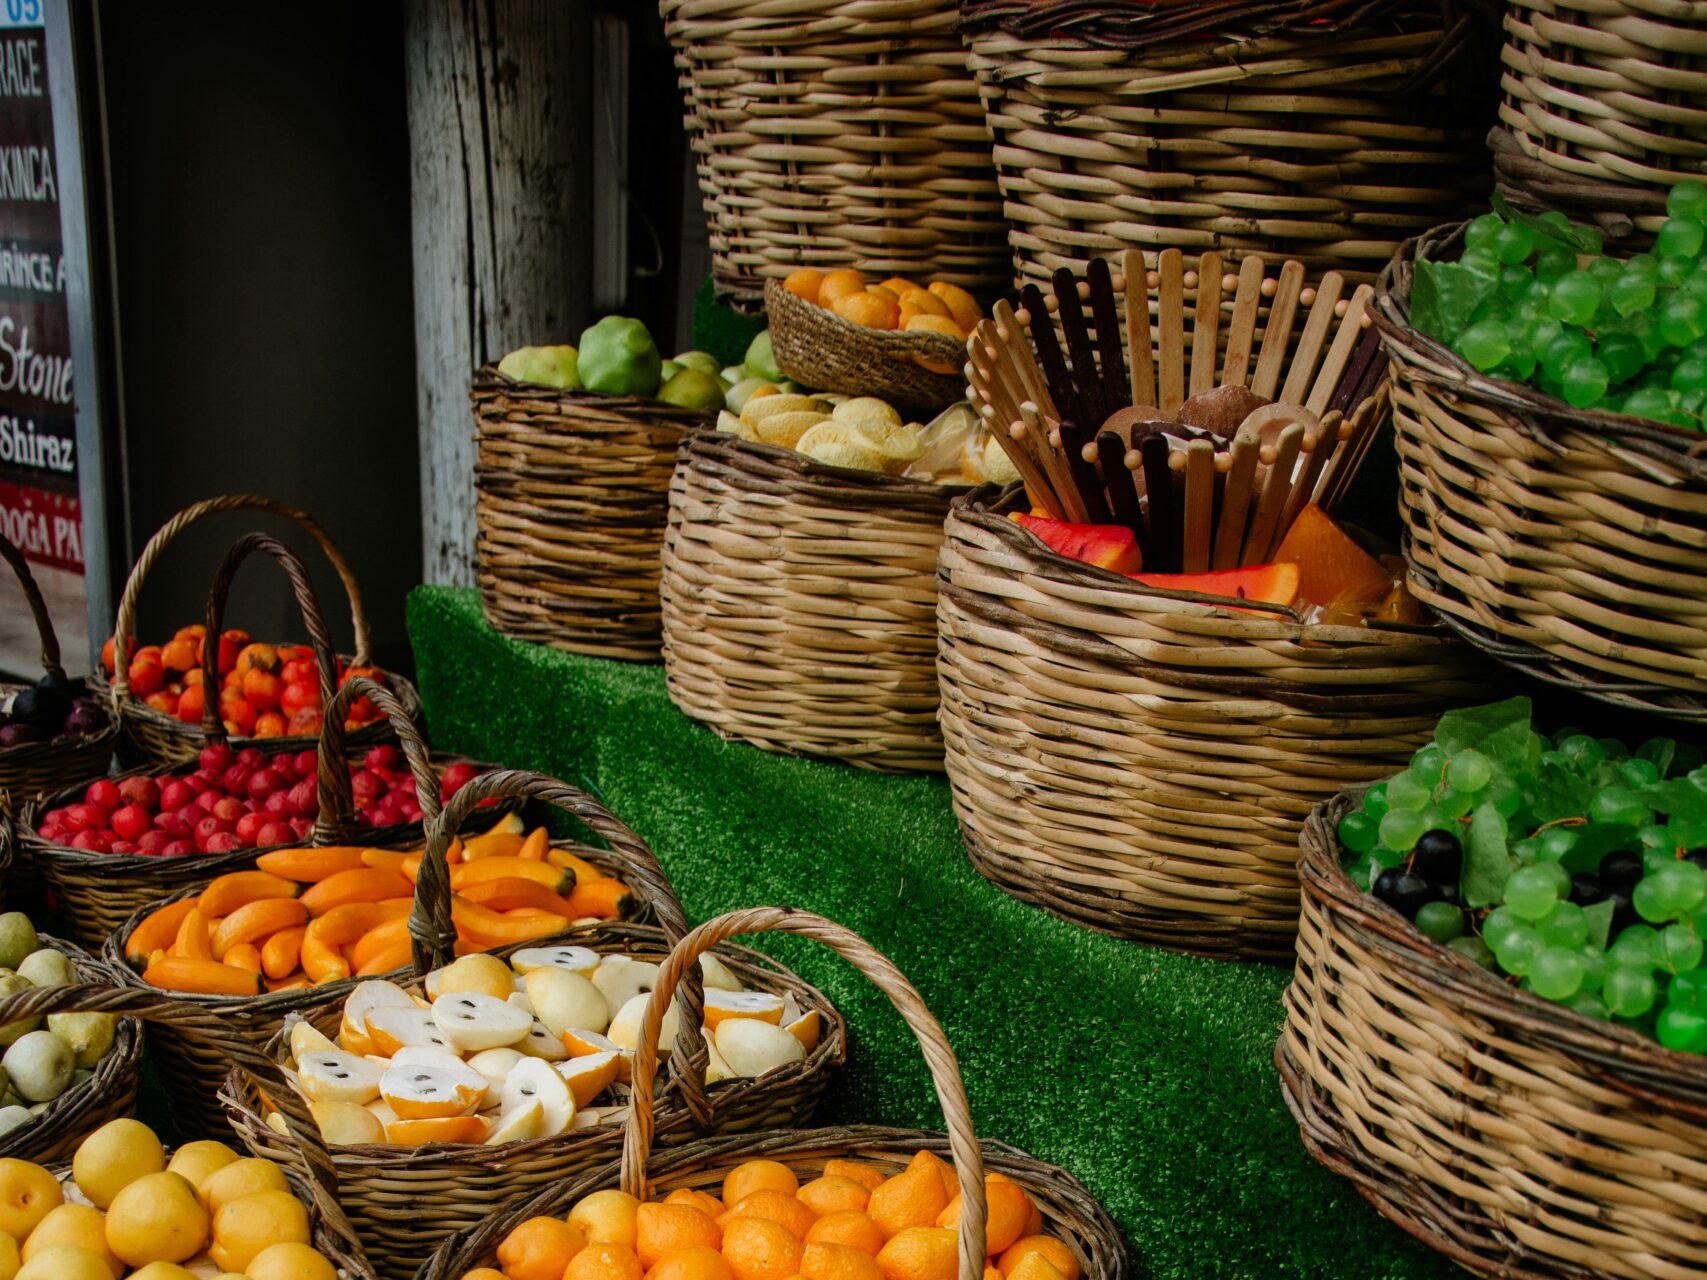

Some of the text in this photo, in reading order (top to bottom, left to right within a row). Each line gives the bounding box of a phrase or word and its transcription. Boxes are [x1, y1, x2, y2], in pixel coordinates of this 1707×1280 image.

[0, 144, 57, 202] KINCA
[0, 315, 73, 404] Stone
[0, 414, 74, 472] Shiraz
[53, 515, 84, 563] PA
